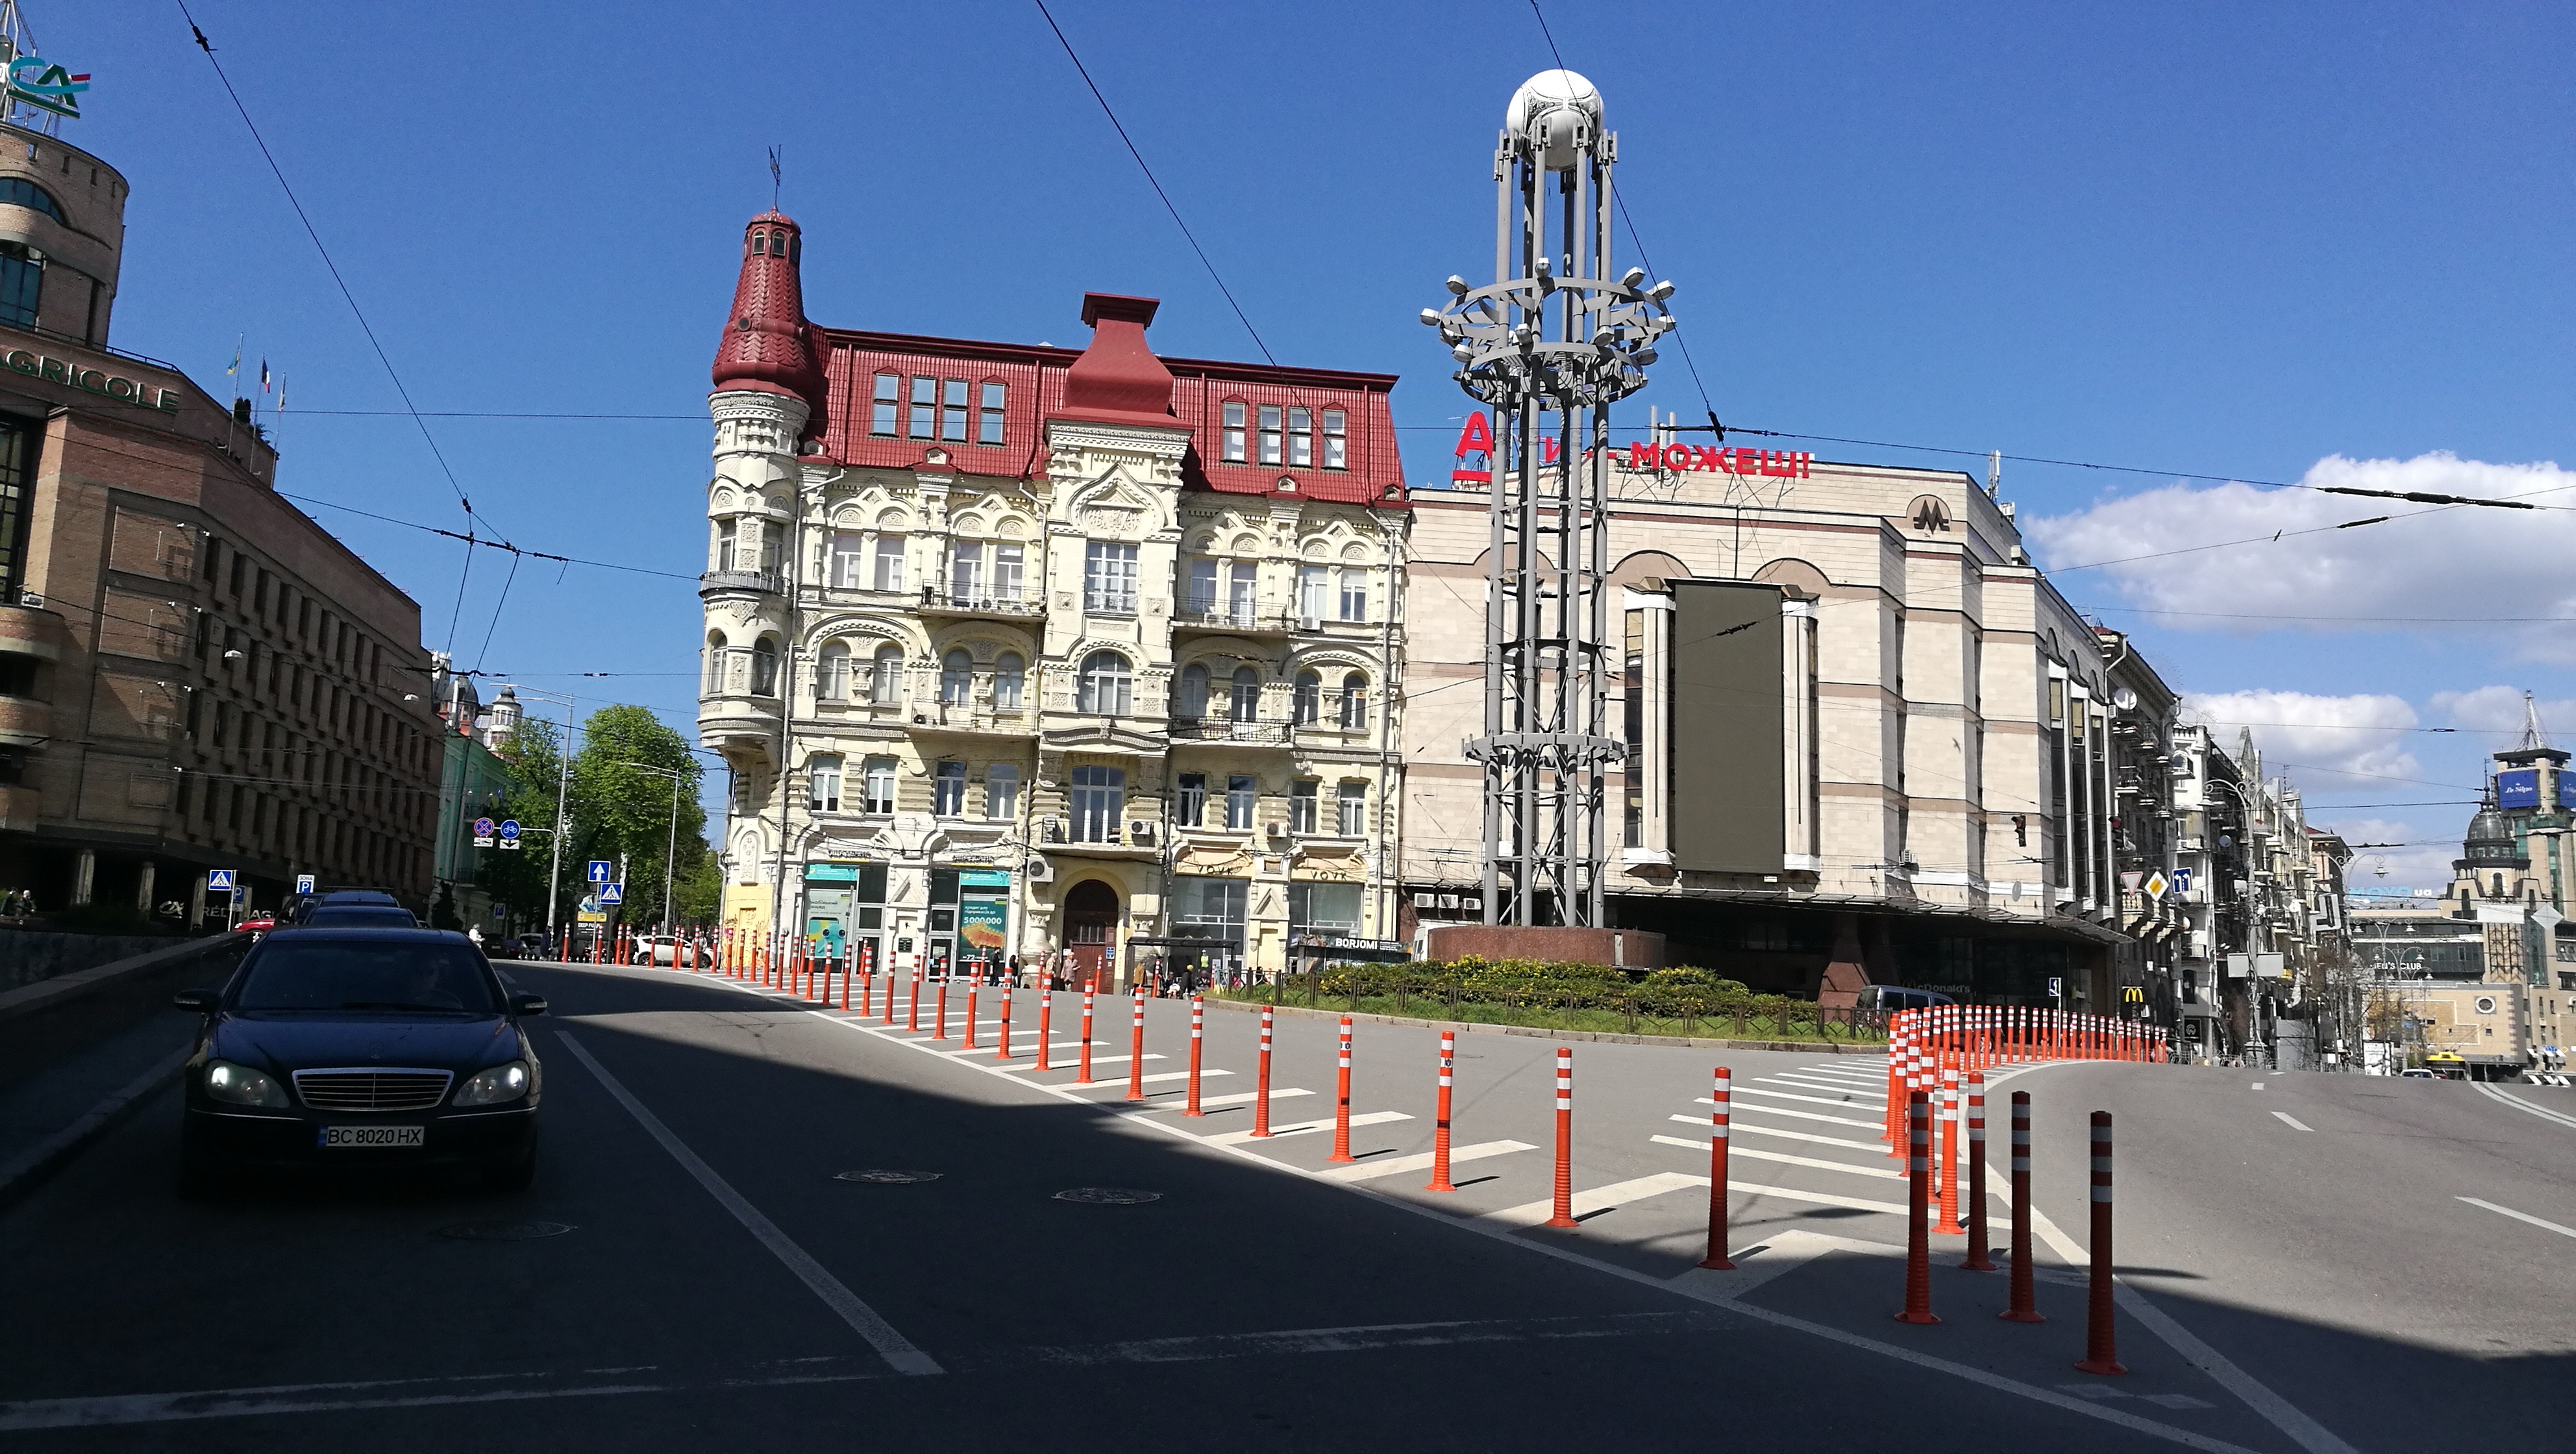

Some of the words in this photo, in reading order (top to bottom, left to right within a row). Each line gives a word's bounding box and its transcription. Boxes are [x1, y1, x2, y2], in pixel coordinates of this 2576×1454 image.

[0, 349, 180, 414] GRICOLE
[1630, 441, 1810, 478] МОЖЕШ!
[1310, 870, 1347, 881] VOVK
[1335, 937, 1378, 950] BORJOMI
[328, 1129, 352, 1143] BC
[356, 1129, 395, 1143] 8020
[397, 1129, 421, 1143] HX
